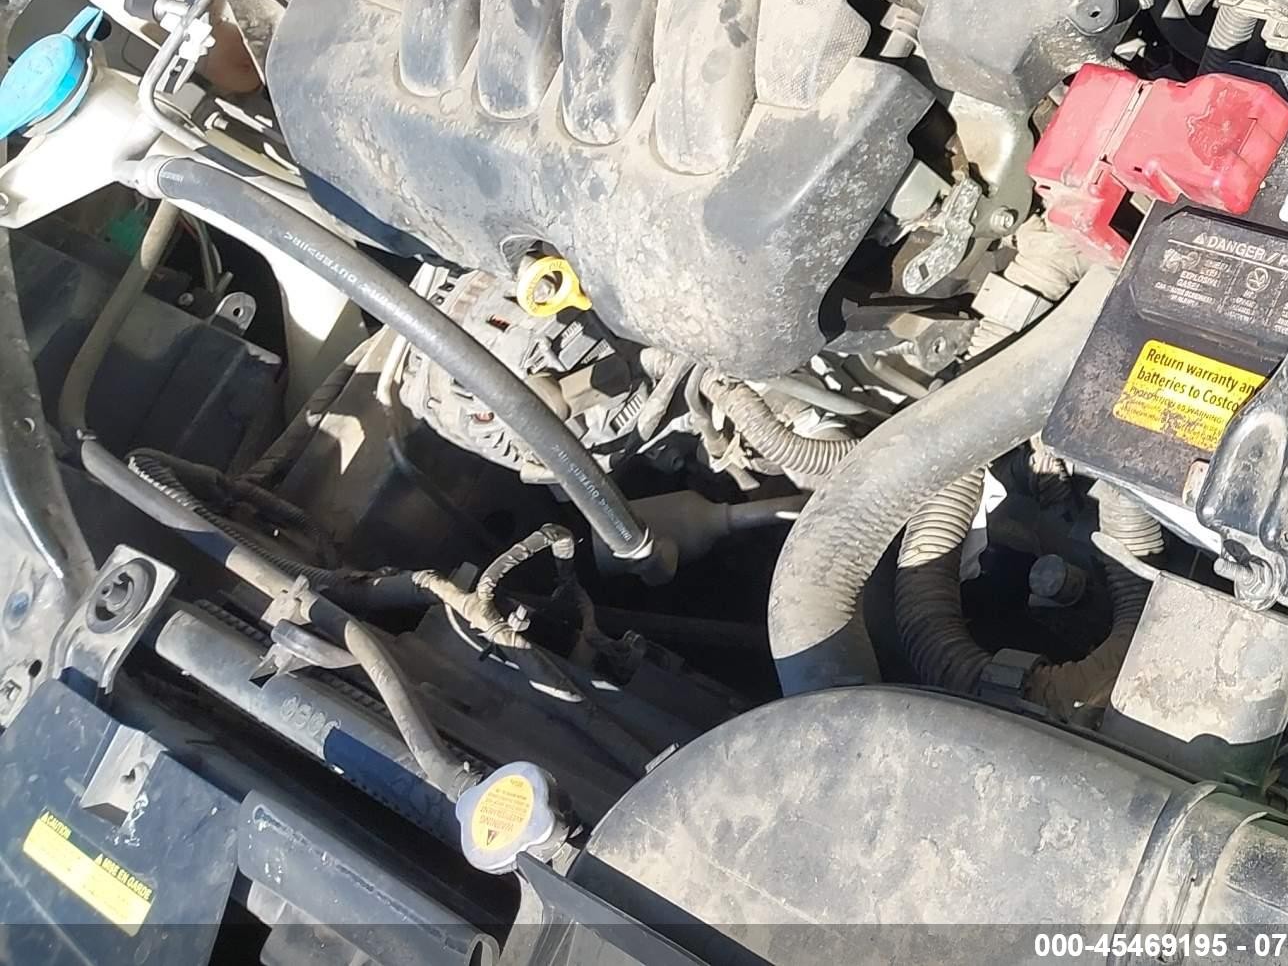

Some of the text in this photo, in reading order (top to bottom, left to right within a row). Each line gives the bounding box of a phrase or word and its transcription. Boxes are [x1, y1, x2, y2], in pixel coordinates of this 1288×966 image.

[1206, 234, 1266, 261] DANGER
[1137, 366, 1240, 413] batteries to Costco
[1146, 348, 1258, 395] Return warranty an
[125, 876, 153, 901] GARDE
